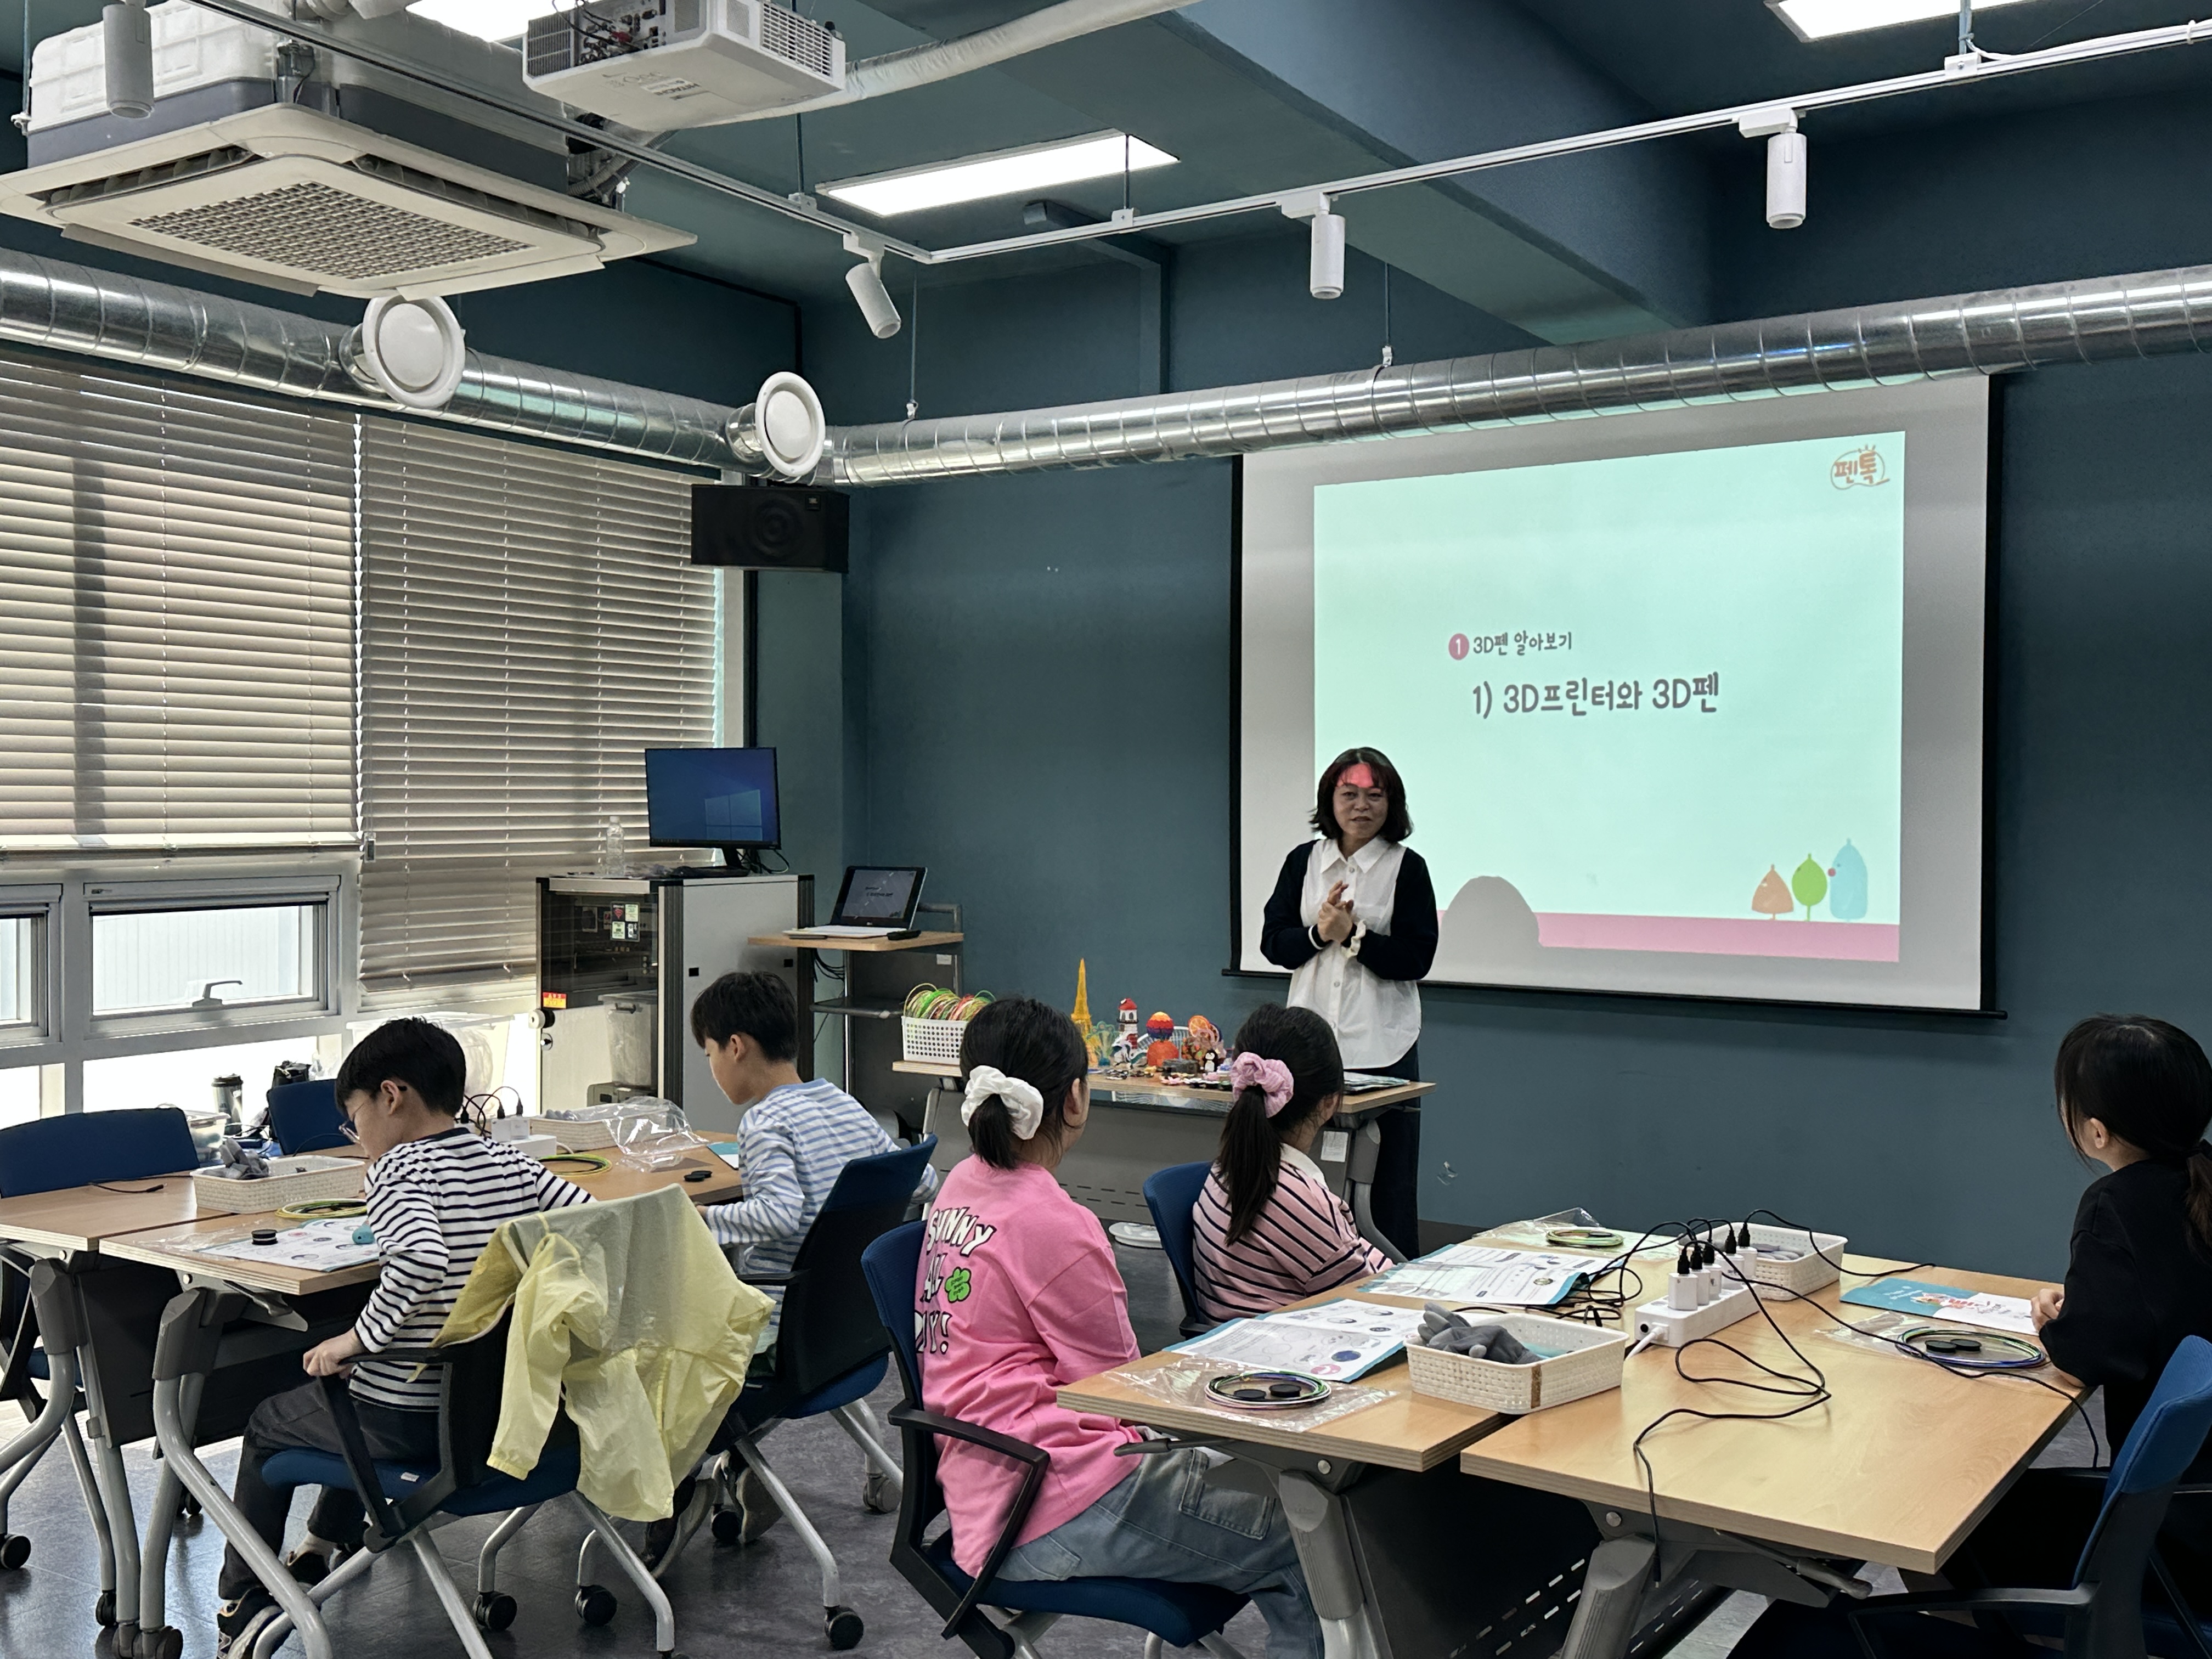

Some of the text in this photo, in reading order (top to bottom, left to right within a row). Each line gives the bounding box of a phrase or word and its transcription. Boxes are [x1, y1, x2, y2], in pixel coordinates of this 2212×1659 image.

[1834, 451, 1877, 484] 펜톡
[1473, 631, 1508, 656] 3D펜
[1514, 630, 1572, 656] 알아보기
[1472, 671, 1719, 720] 1) 3D프린터와 3D펜
[927, 1206, 997, 1257] SUNNY
